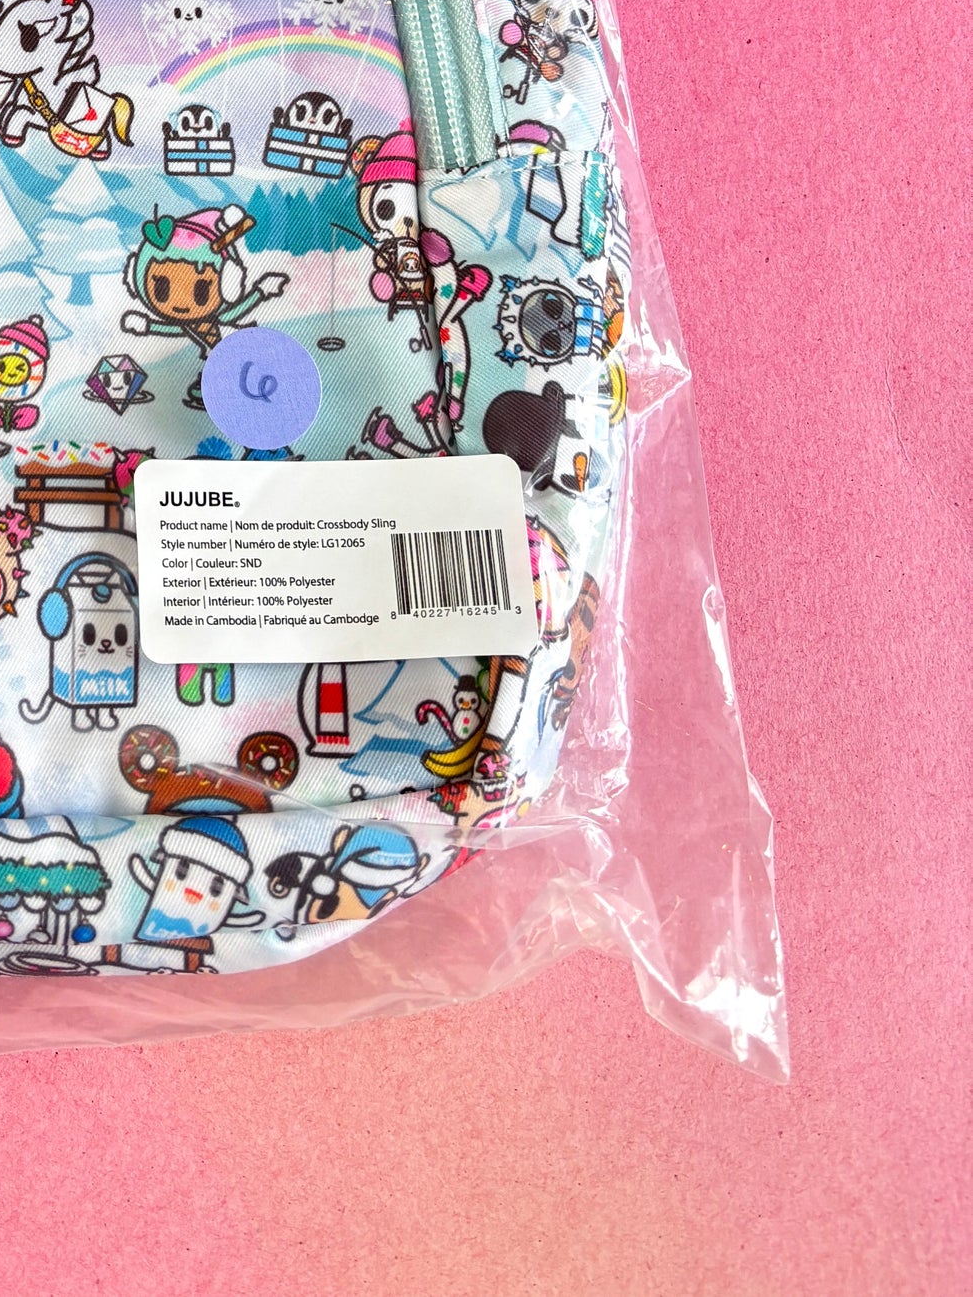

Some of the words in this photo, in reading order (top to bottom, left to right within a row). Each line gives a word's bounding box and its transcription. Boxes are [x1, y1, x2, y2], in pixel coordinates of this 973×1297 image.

[239, 361, 279, 403] 6
[159, 519, 199, 531] Product
[200, 521, 228, 531] name
[235, 520, 259, 531] Nom
[261, 519, 274, 531] de
[276, 519, 316, 532] produit:
[317, 518, 369, 531] Crossbody
[371, 518, 396, 530] Sling
[160, 538, 185, 552] Style
[187, 539, 227, 550] number
[234, 538, 276, 550] Numéro
[277, 538, 291, 549] de
[293, 538, 320, 551] style:
[321, 537, 366, 549] LG12065
[161, 557, 188, 569] Color
[195, 557, 238, 569] Couleur:
[239, 557, 263, 569] SND
[162, 577, 201, 588] Exterior
[208, 576, 257, 588] Extérieur:
[259, 577, 287, 587] 100%
[289, 576, 336, 589] Polyester
[163, 596, 200, 607] Interior
[208, 595, 255, 606] Intérieur:
[257, 596, 284, 606] 100%
[286, 595, 333, 608] Polyester
[412, 608, 451, 619] 40227
[459, 606, 497, 617] 16245
[164, 615, 193, 626] Made
[195, 615, 204, 626] in
[206, 615, 257, 626] Cambodia
[263, 614, 307, 628] Fabriqué
[308, 616, 321, 625] au
[323, 613, 380, 626] Cambodge
